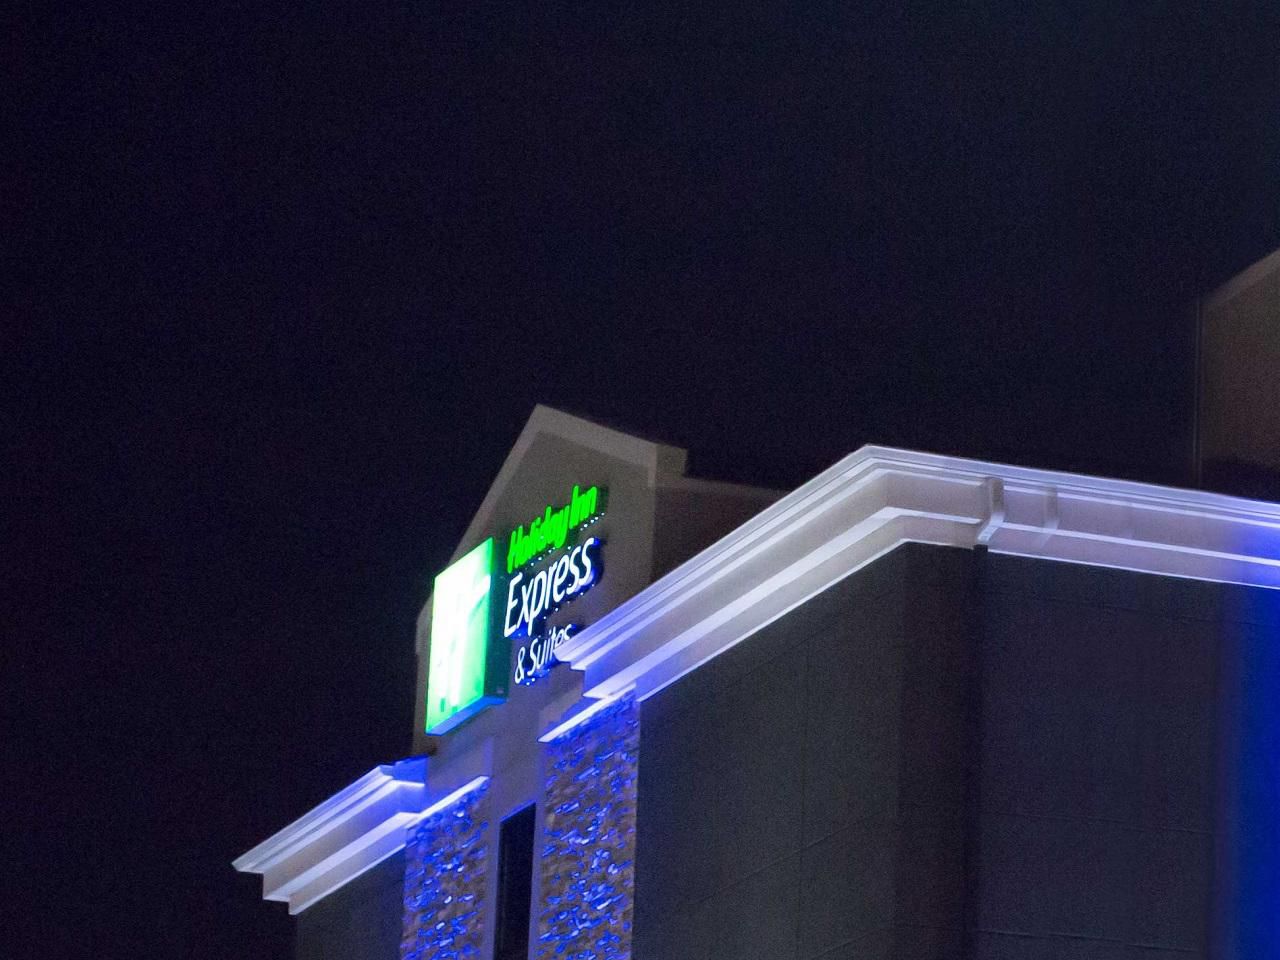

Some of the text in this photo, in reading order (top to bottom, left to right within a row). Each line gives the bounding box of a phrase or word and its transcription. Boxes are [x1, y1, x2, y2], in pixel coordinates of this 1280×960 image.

[507, 485, 599, 573] Holiday Inn
[504, 537, 595, 638] Express
[514, 646, 526, 685] &
